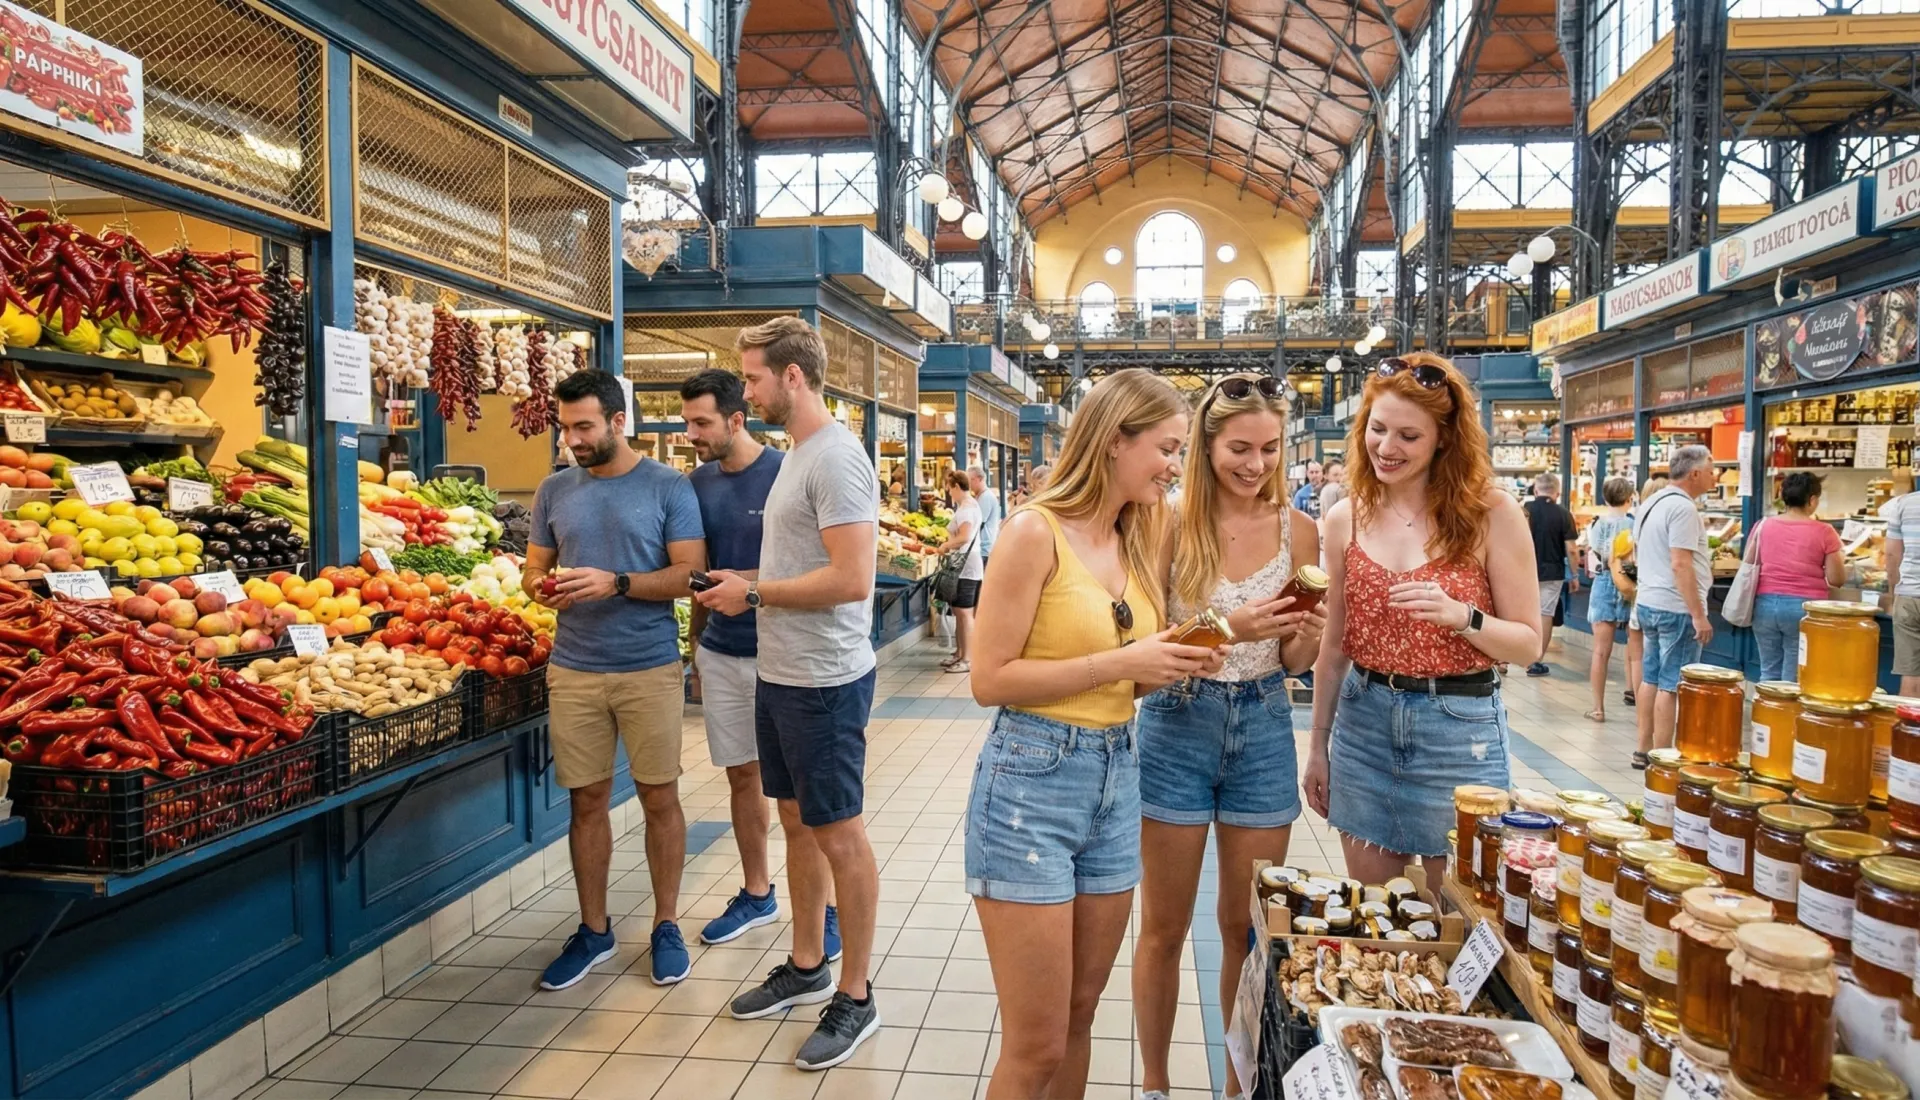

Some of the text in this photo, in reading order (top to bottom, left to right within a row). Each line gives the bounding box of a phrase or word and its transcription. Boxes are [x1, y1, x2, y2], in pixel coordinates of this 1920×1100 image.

[14, 46, 102, 97] PAPPHIKI
[541, 0, 686, 114] GYCSARKT
[1887, 158, 1920, 191] PÍO
[1610, 264, 1693, 318] NAGYCSARNOK
